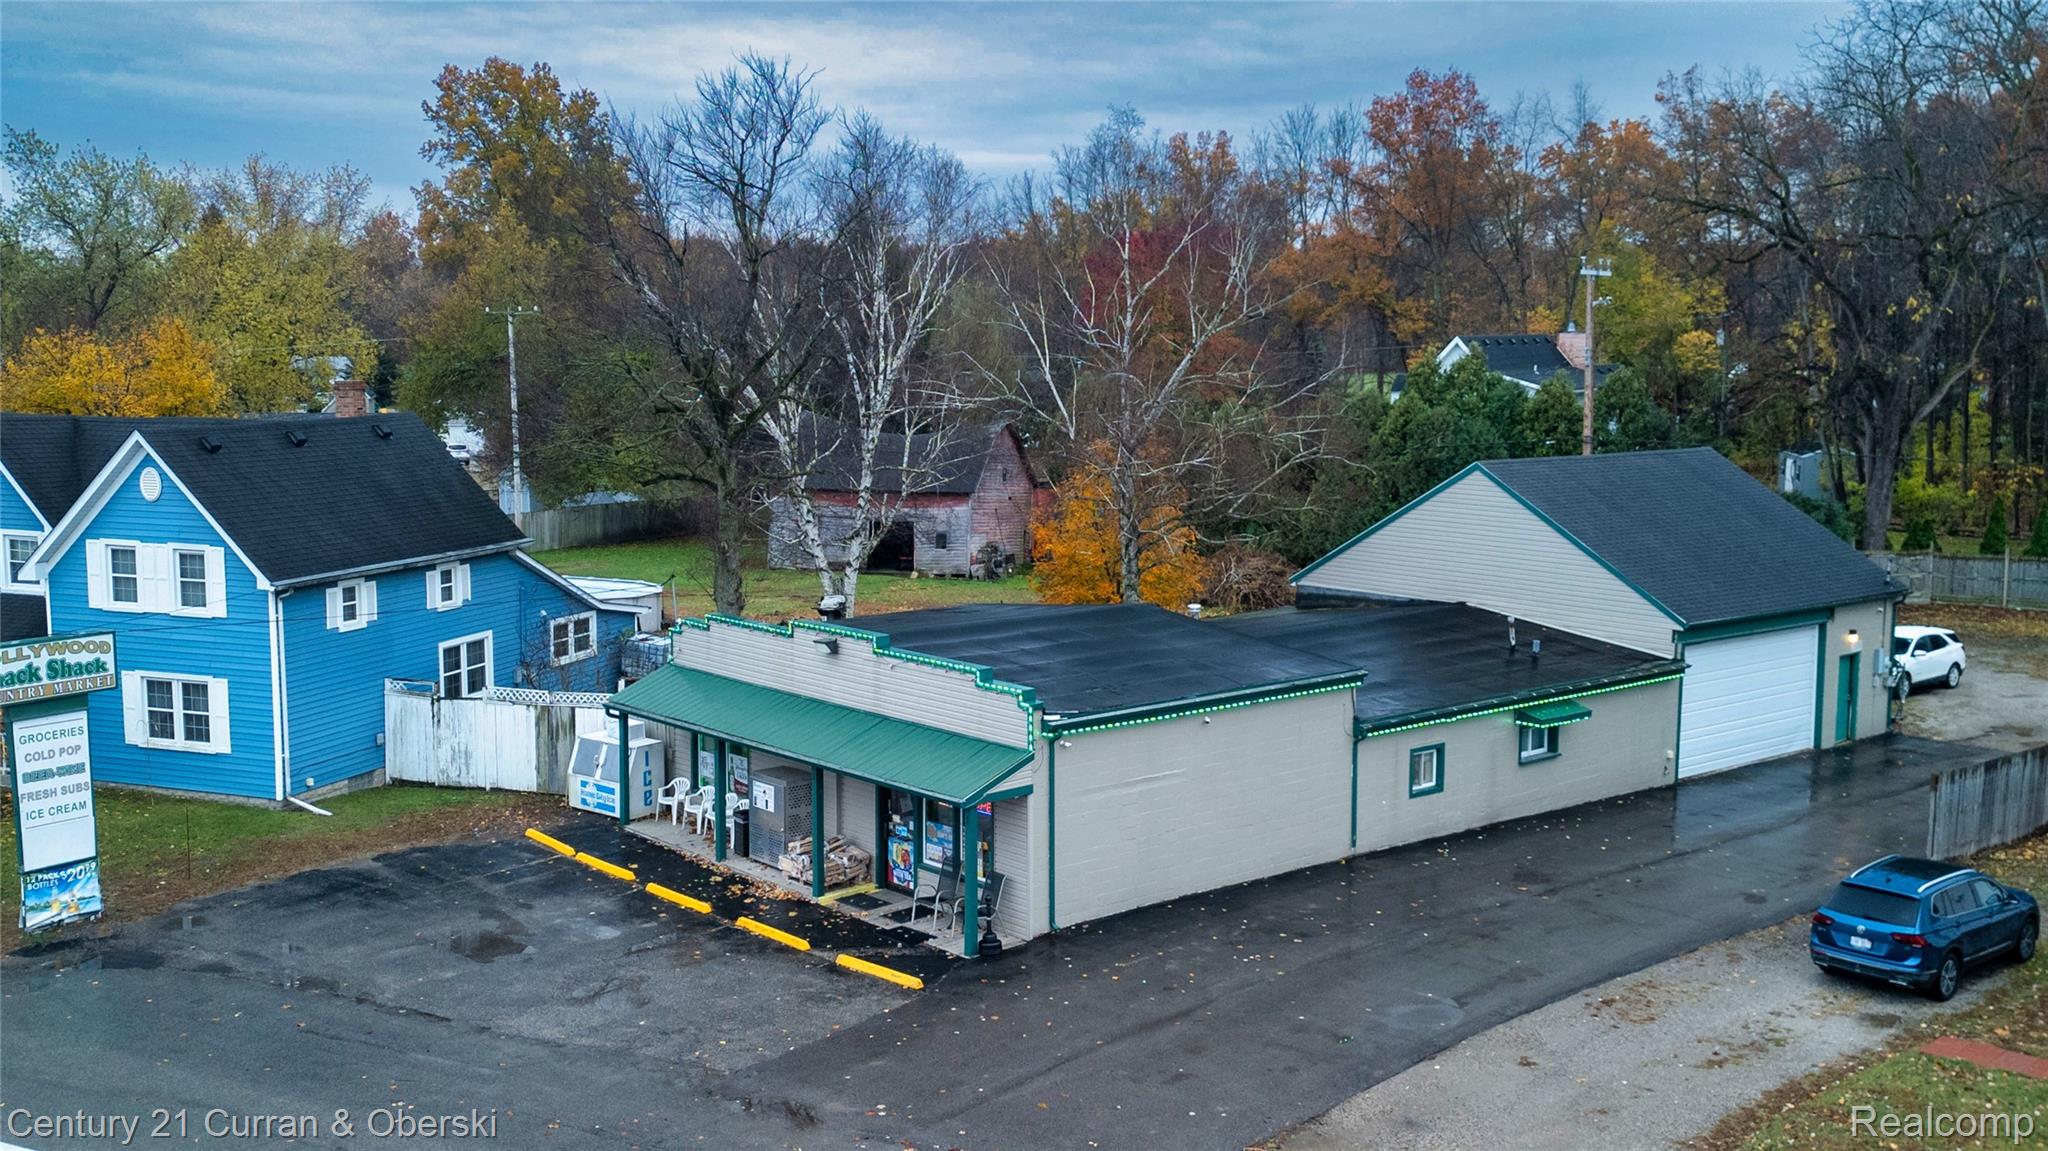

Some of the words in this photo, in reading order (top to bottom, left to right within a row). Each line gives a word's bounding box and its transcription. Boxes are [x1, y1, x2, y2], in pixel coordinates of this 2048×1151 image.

[0, 640, 112, 665] LLYWOOD
[46, 657, 109, 681] Shack
[54, 675, 113, 694] MARKET
[18, 726, 84, 745] GROCERIES
[24, 749, 56, 763] COLD
[58, 744, 82, 758] POP
[20, 787, 58, 804] FRESH
[60, 781, 90, 796] SUBS
[26, 809, 45, 821] ICE
[48, 800, 87, 816] CREAM
[26, 876, 36, 884] 12
[27, 879, 59, 891] BOTTLES
